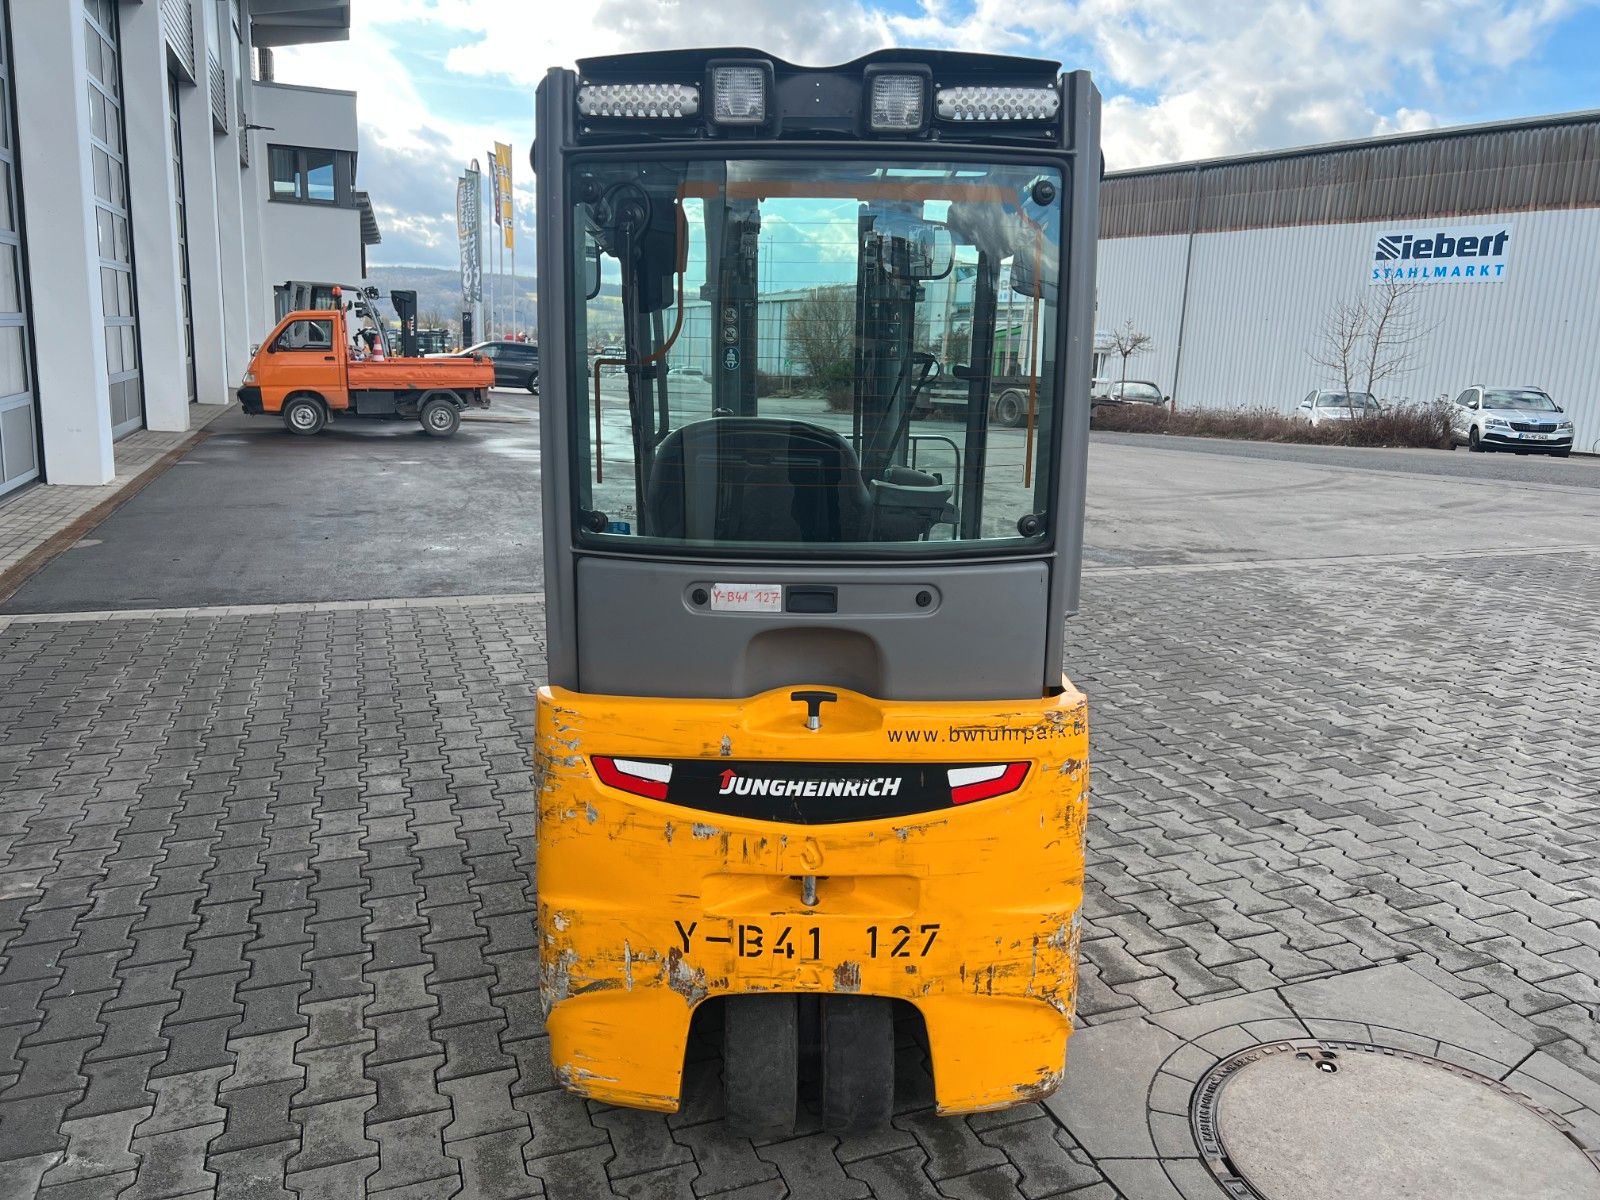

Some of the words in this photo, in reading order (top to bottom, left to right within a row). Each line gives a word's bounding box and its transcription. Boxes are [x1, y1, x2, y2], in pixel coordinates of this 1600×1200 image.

[1375, 230, 1509, 261] Siebert
[1372, 264, 1505, 280] STAHLMARKT
[713, 591, 748, 604] Y-B41
[754, 592, 781, 604] 127
[718, 776, 902, 797] JUNGHEINRICH
[866, 923, 940, 959] 127
